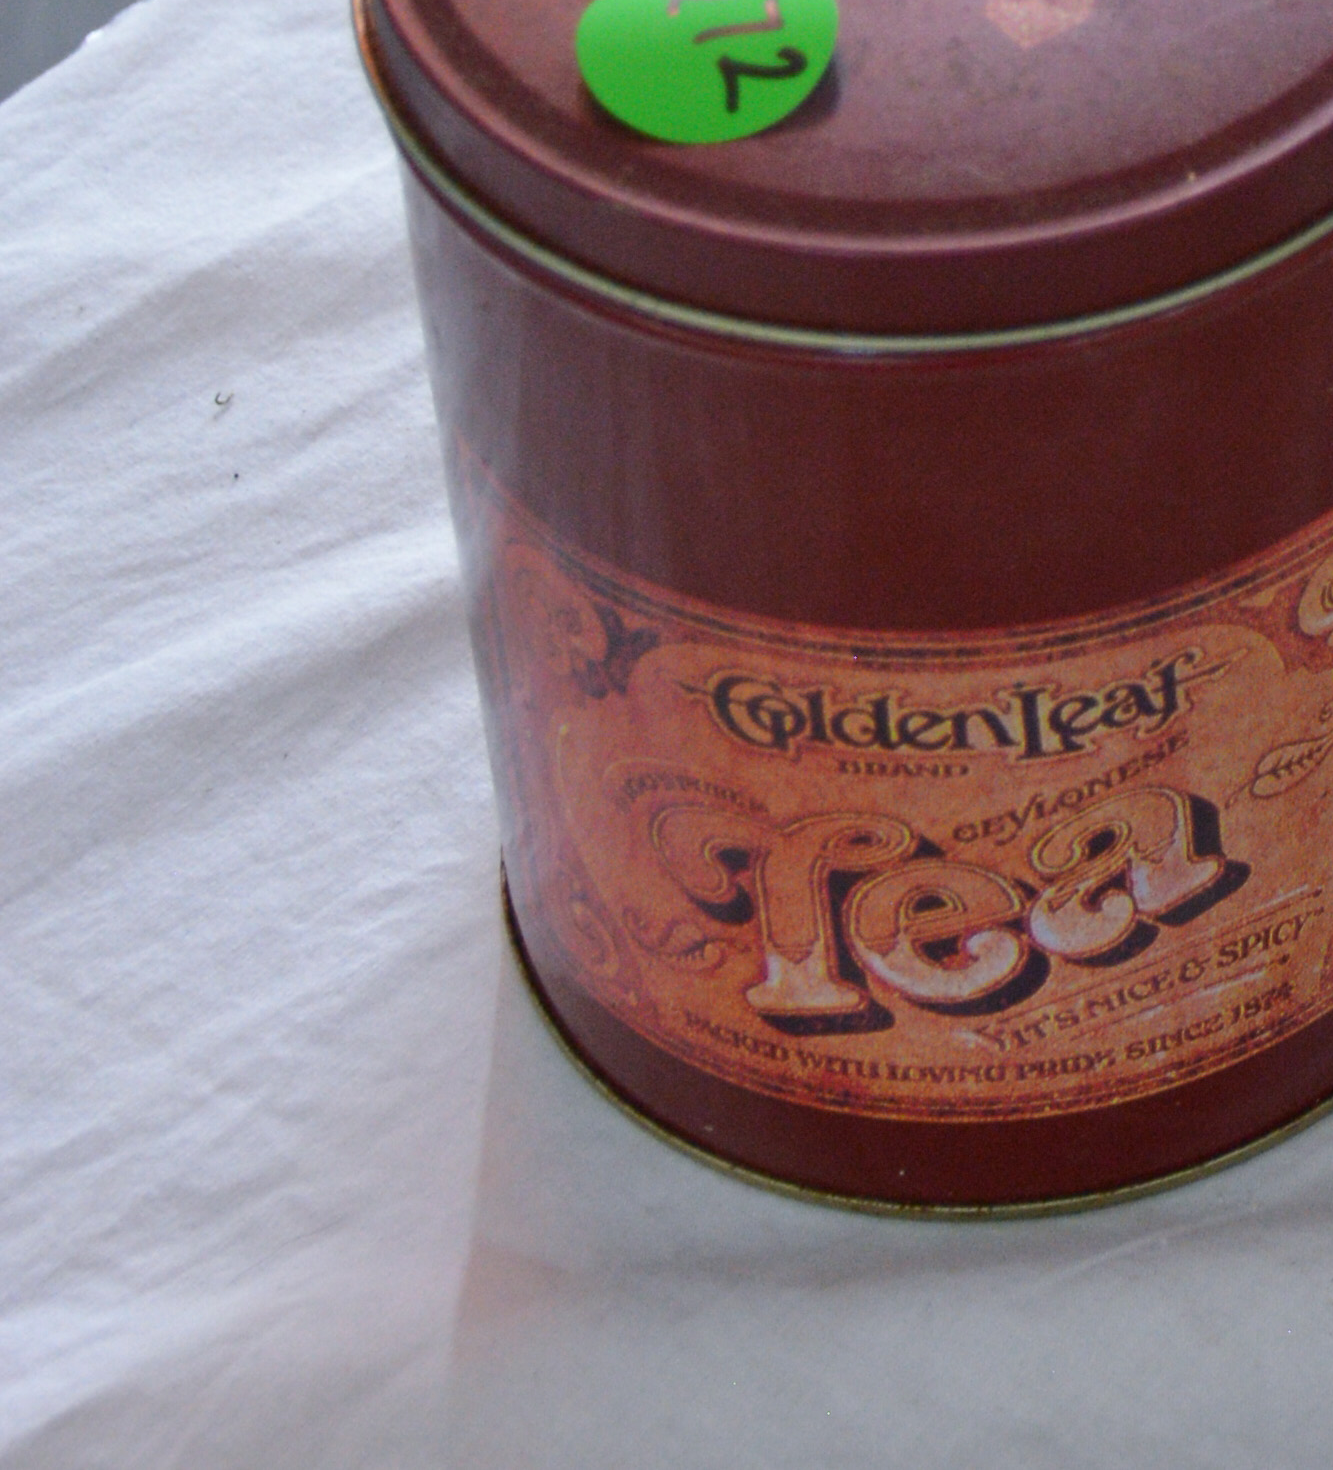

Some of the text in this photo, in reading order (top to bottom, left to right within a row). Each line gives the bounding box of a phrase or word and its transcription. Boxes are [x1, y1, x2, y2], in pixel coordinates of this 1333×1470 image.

[692, 649, 1216, 761] Golden Leaf
[836, 760, 970, 778] BRAND
[952, 728, 1191, 847] CEYLONESE
[649, 786, 1251, 1036] Tea
[1087, 969, 1175, 1019] NICE
[1178, 960, 1206, 985] &
[797, 1049, 881, 1081] WITH
[1126, 1015, 1225, 1059] SINCE
